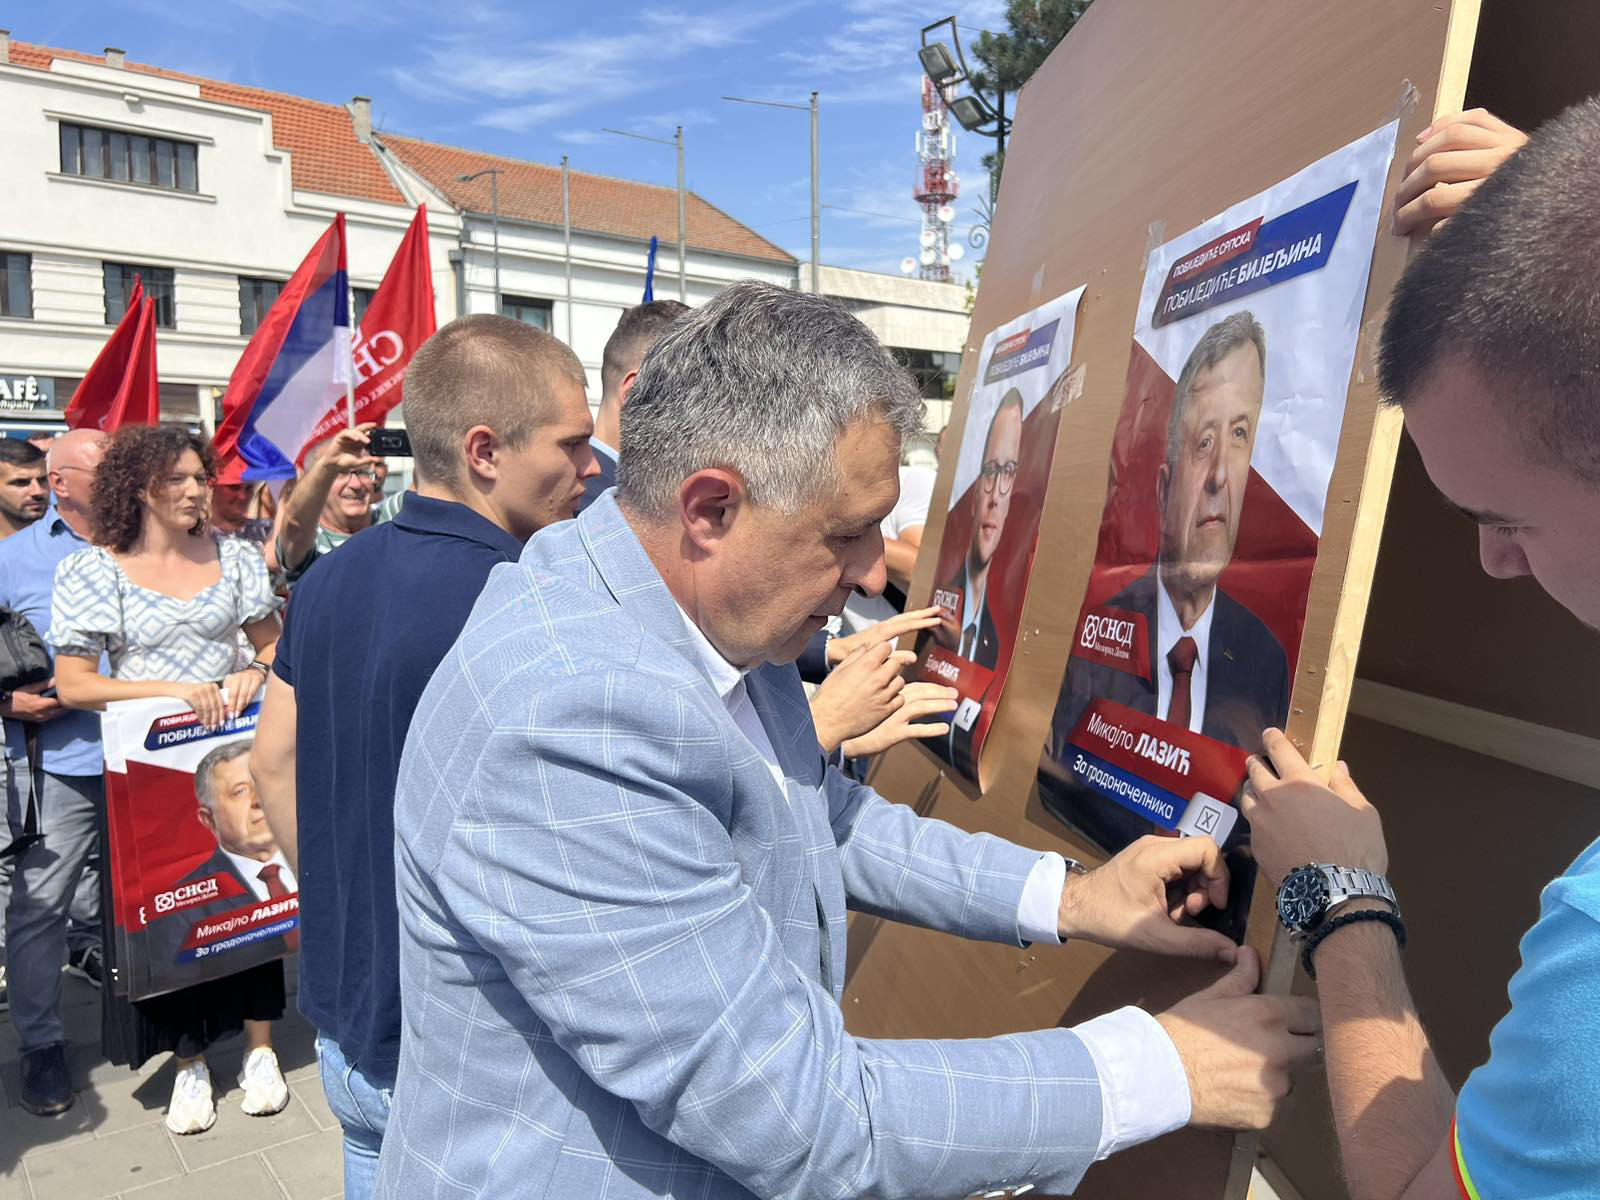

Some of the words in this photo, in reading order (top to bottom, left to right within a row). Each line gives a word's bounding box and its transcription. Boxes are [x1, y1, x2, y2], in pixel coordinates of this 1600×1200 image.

[1219, 231, 1251, 256] СРПСКА
[1164, 268, 1237, 314] ПОБИЈЕДИЋЕ
[1237, 233, 1322, 285] БИЈЕЉИНА
[1099, 617, 1136, 648] СНСД
[1087, 712, 1134, 750] Микајло
[1134, 732, 1190, 776] ЛАЗИЋ
[1073, 754, 1086, 774] За
[1086, 766, 1174, 820] градоначелника
[175, 879, 218, 900] СНСД
[196, 915, 249, 939] Микајло
[250, 897, 299, 922] ЛАЗИЋ
[195, 947, 210, 958] За
